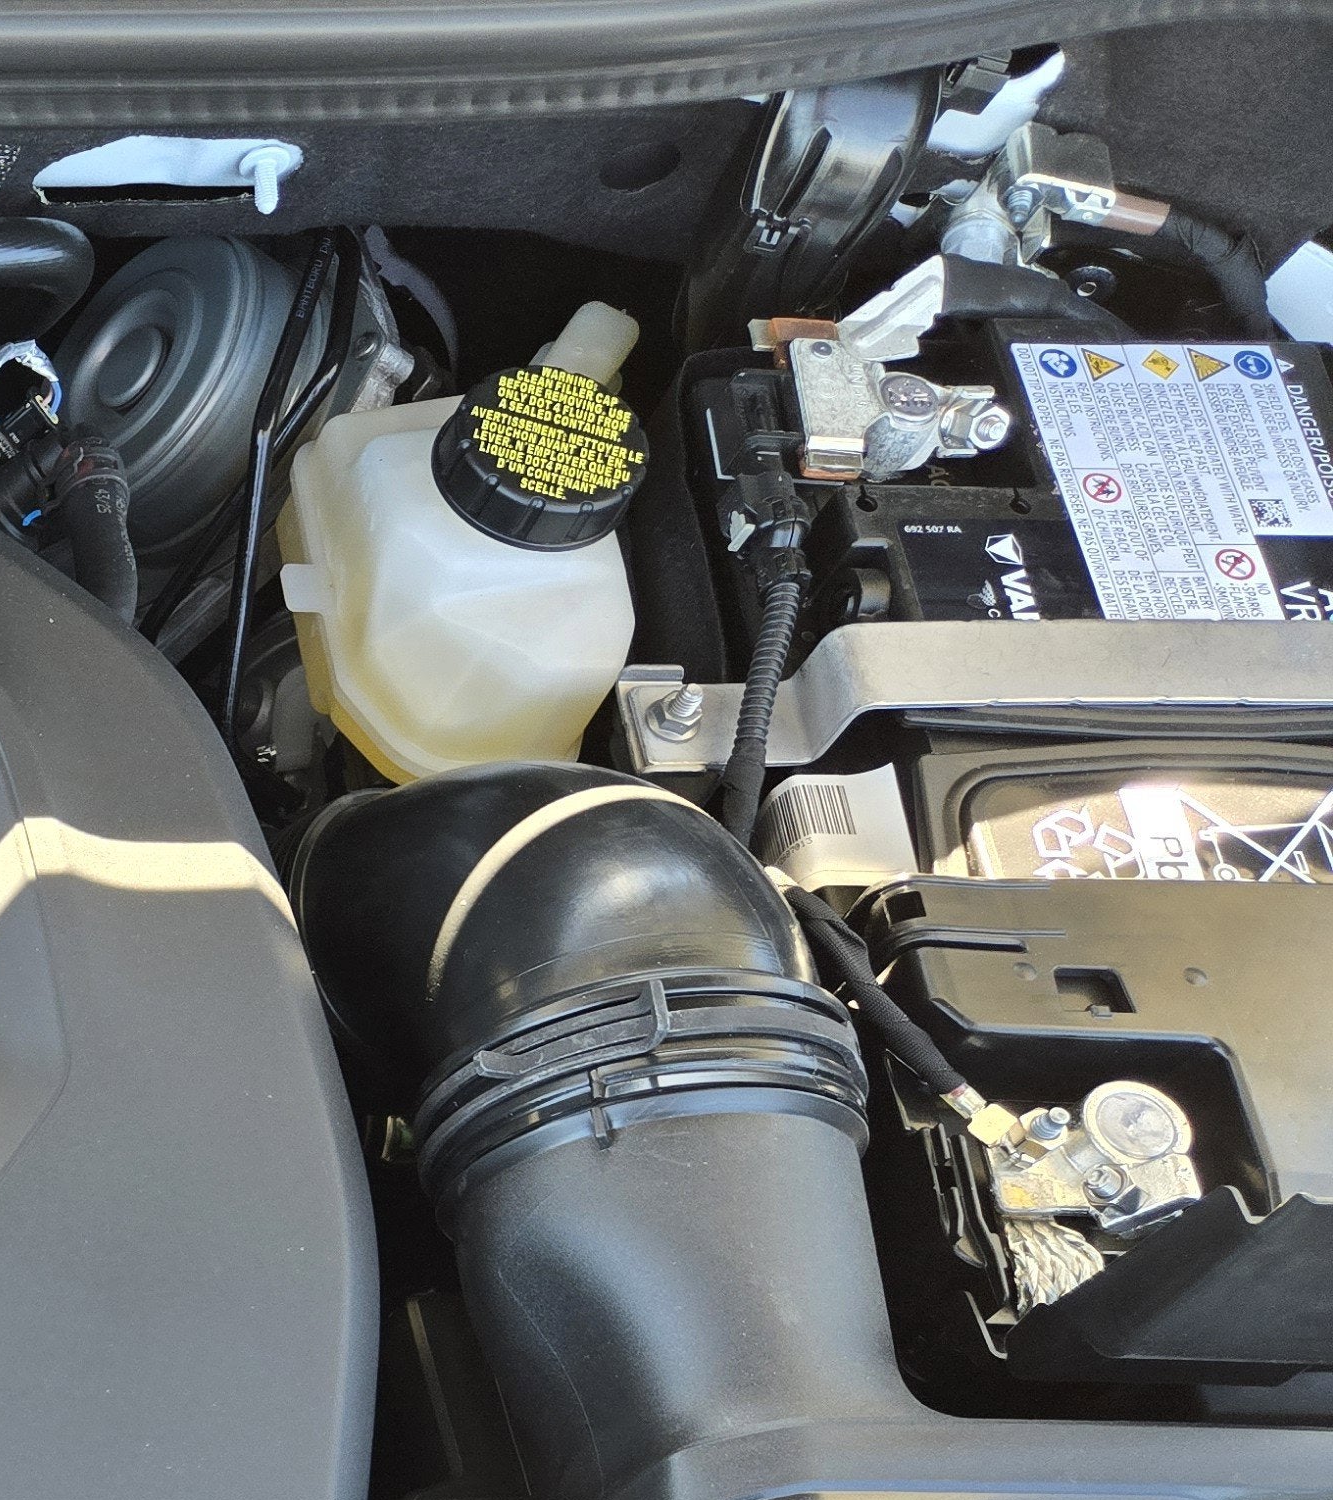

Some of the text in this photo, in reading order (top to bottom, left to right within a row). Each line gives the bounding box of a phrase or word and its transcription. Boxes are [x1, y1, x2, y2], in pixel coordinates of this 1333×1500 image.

[498, 375, 632, 422] BEFORE REMOVING. USE
[515, 369, 619, 407] CLEAN FILLER CAP
[540, 366, 598, 391] WARNING:
[496, 386, 629, 433] ONLY DOT 4 FLUID FROM
[498, 397, 623, 441] A SEALED CONTAINER.
[470, 404, 644, 464] AVERTISSEMENT: NETTOYER LE
[472, 427, 515, 448] LEVER.
[587, 460, 614, 477] QUE
[614, 468, 631, 482] DU
[480, 419, 538, 444] BOUCHON
[537, 435, 577, 456] AVANT
[478, 441, 621, 490] LIQUIDE PROVENANT
[496, 457, 598, 495] D'UN CONTENANT
